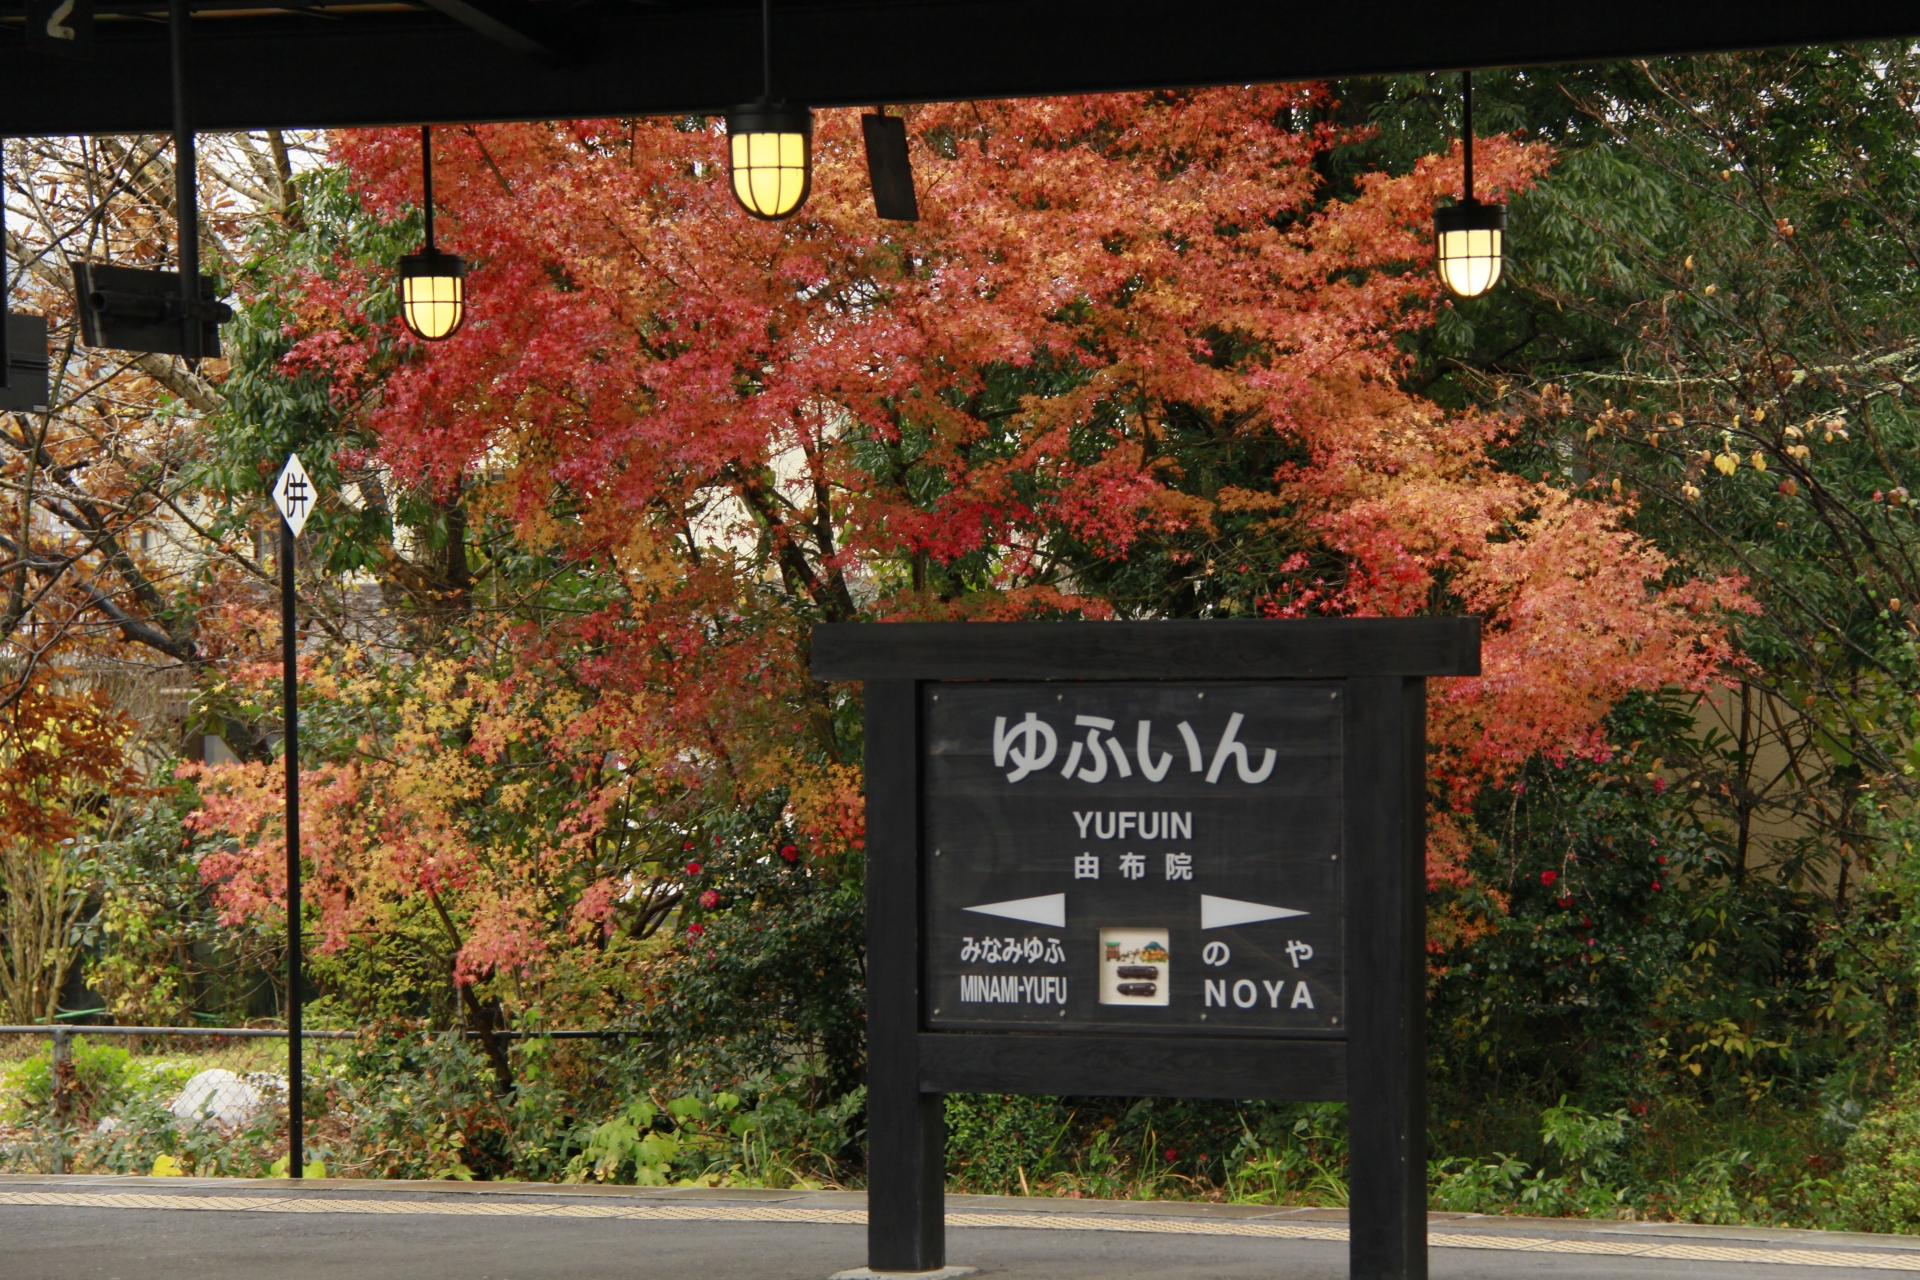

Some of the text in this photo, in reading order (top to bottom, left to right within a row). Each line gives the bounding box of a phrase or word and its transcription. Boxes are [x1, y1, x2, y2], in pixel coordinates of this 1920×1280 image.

[993, 712, 1277, 784] ゆふいん
[1073, 811, 1192, 840] YUFUIN
[1074, 852, 1193, 881] 由布院
[960, 937, 1066, 964] みなみゆふ
[960, 975, 1067, 1005] MINAMI-YUFU
[1205, 979, 1315, 1009] NOYA
